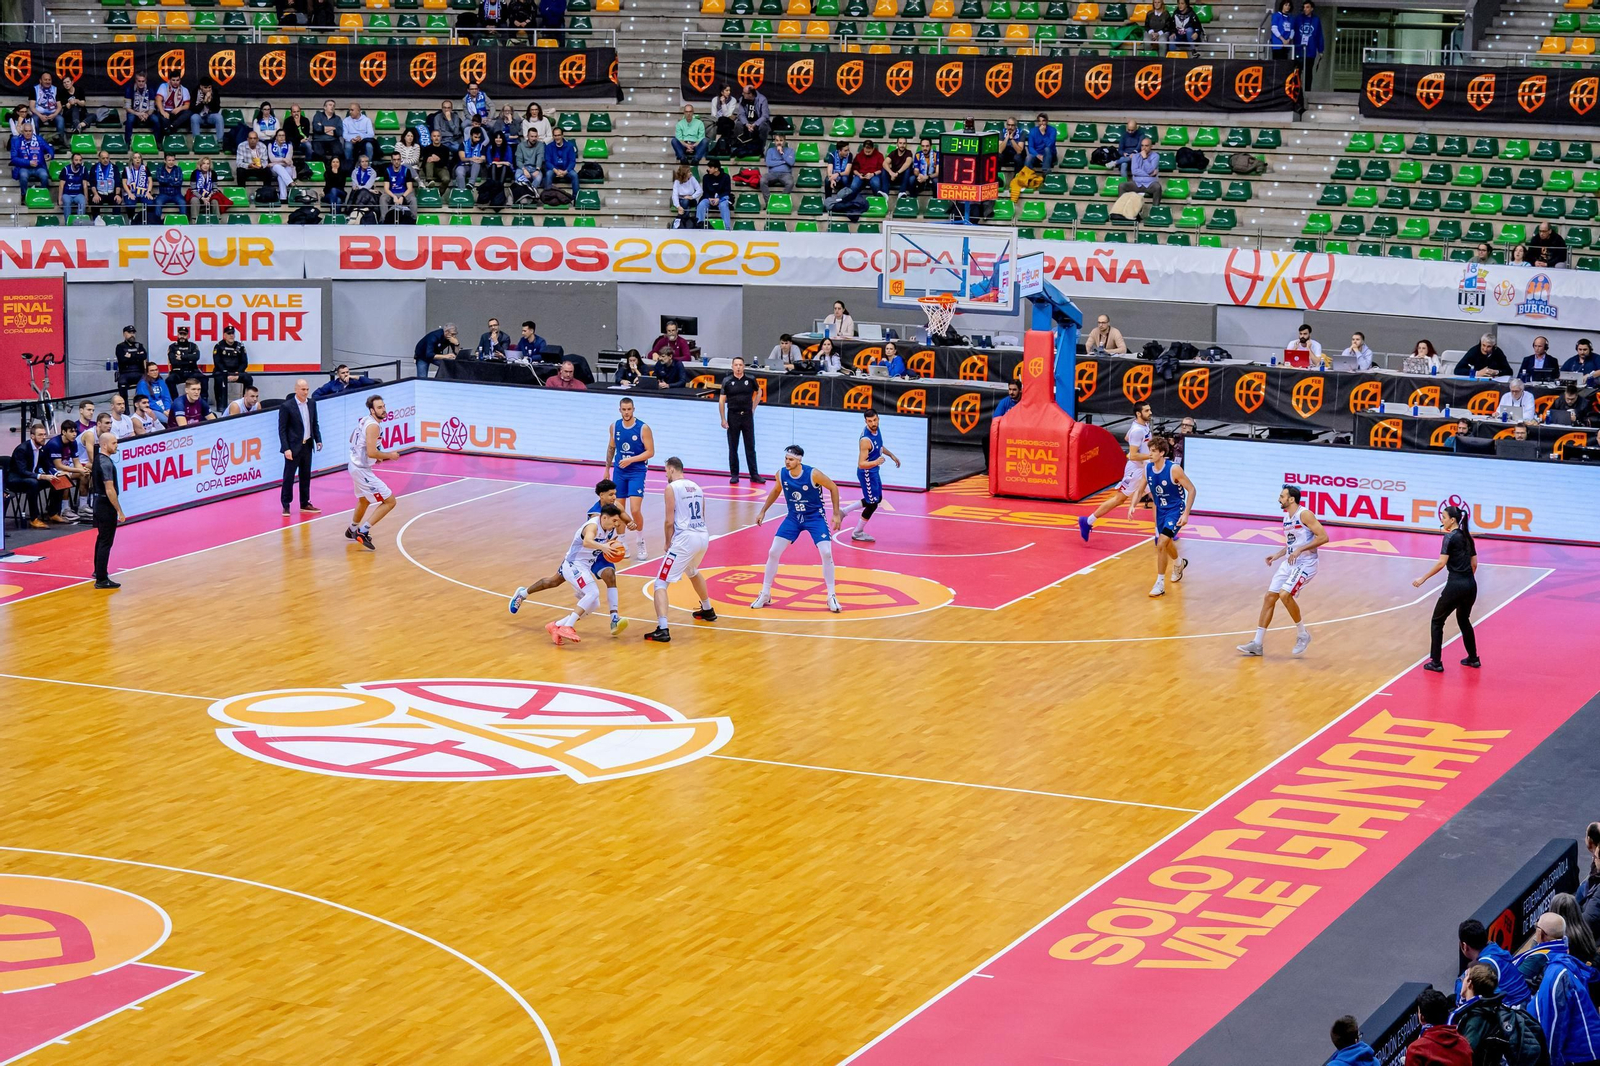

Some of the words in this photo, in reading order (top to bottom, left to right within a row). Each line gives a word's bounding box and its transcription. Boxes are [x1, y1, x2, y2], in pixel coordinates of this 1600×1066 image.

[950, 138, 979, 152] 3:44
[954, 158, 975, 184] 13
[941, 190, 976, 200] GANAR
[837, 248, 961, 274] COPA
[3, 302, 53, 314] FINAL
[167, 294, 233, 308] SOLO
[242, 294, 302, 308] VALE
[1518, 304, 1557, 317] BURGOS
[160, 312, 310, 341] GANAR
[1006, 447, 1059, 462] FINAL
[122, 454, 193, 491] FINAL
[196, 479, 223, 493] COPA
[224, 467, 262, 487] ESPAÑA
[688, 501, 701, 520] 12
[718, 572, 757, 584] FEB
[1172, 709, 1512, 870] GANAR
[1048, 864, 1234, 966] SOLO
[1133, 878, 1322, 970] VALE
[1398, 1012, 1420, 1048] ESPAÑOL
